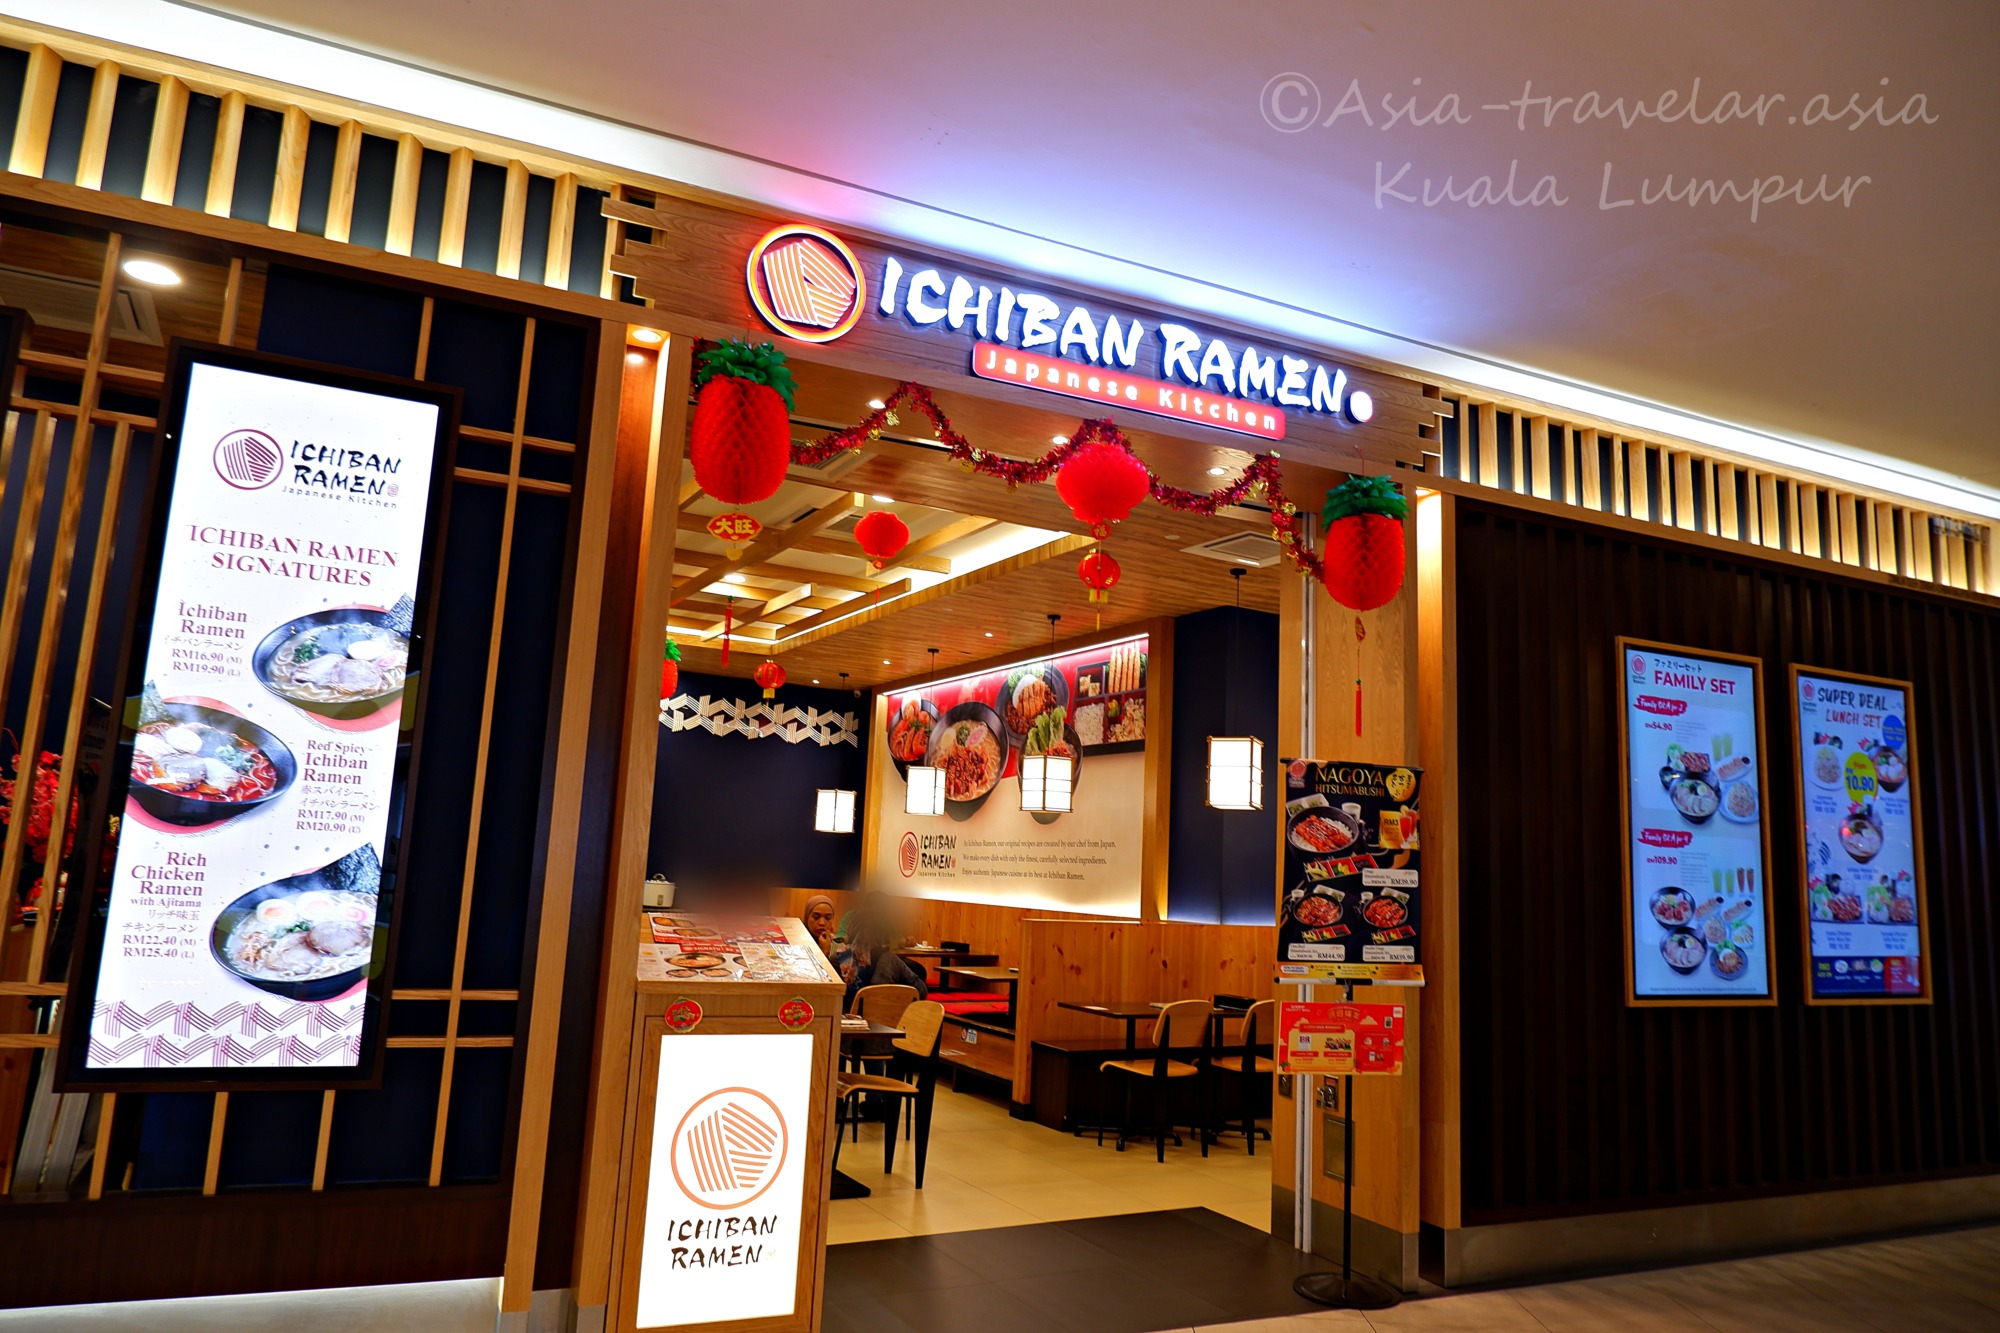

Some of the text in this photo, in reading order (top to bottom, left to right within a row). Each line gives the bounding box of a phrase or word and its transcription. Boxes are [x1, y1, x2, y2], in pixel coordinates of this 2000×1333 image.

[881, 256, 1347, 414] ICHIBAN RAMEN
[986, 348, 1277, 432] Japanese Kitchen
[291, 440, 401, 474] ICHIBAN
[294, 464, 386, 495] RAMEN
[282, 485, 397, 509] Japanese Kitchen
[713, 518, 755, 535] 大旺
[187, 523, 398, 568] ICHIBAN RAMEN
[211, 551, 372, 587] SIGNATURES
[179, 601, 247, 623] Ichiban
[181, 619, 245, 639] Ramen
[172, 648, 242, 665] RM16.90 (M)
[173, 661, 241, 677] RM19.90 (L)
[1654, 670, 1707, 691] FAMILY
[1710, 678, 1736, 695] SET
[1817, 687, 1856, 709] SUPER
[1858, 692, 1888, 711] DEAL
[1825, 709, 1882, 728] LUNCH SET
[307, 739, 367, 756] Red Spicy
[305, 752, 368, 770] Ichiban
[303, 768, 362, 785] Ramen
[1315, 767, 1385, 787] NAGOYA
[1846, 775, 1874, 792] 10.90
[1315, 783, 1385, 798] HITSUMABUSHI
[298, 809, 365, 823] RM17.90 (M)
[296, 821, 346, 833] RM20.90
[920, 834, 957, 850] ICHIBAN
[166, 851, 207, 867] Rich
[921, 853, 951, 869] RAMEN
[131, 865, 205, 882] Chicken
[139, 880, 203, 897] Ramen
[130, 897, 202, 908] with Ajitama
[122, 922, 198, 933] チキンラーメン
[122, 934, 196, 947] RM22.40 (M)
[123, 947, 195, 960] RM25.40 (L)
[668, 1215, 777, 1242] ICHIBAN
[671, 1244, 763, 1270] RAMEN
